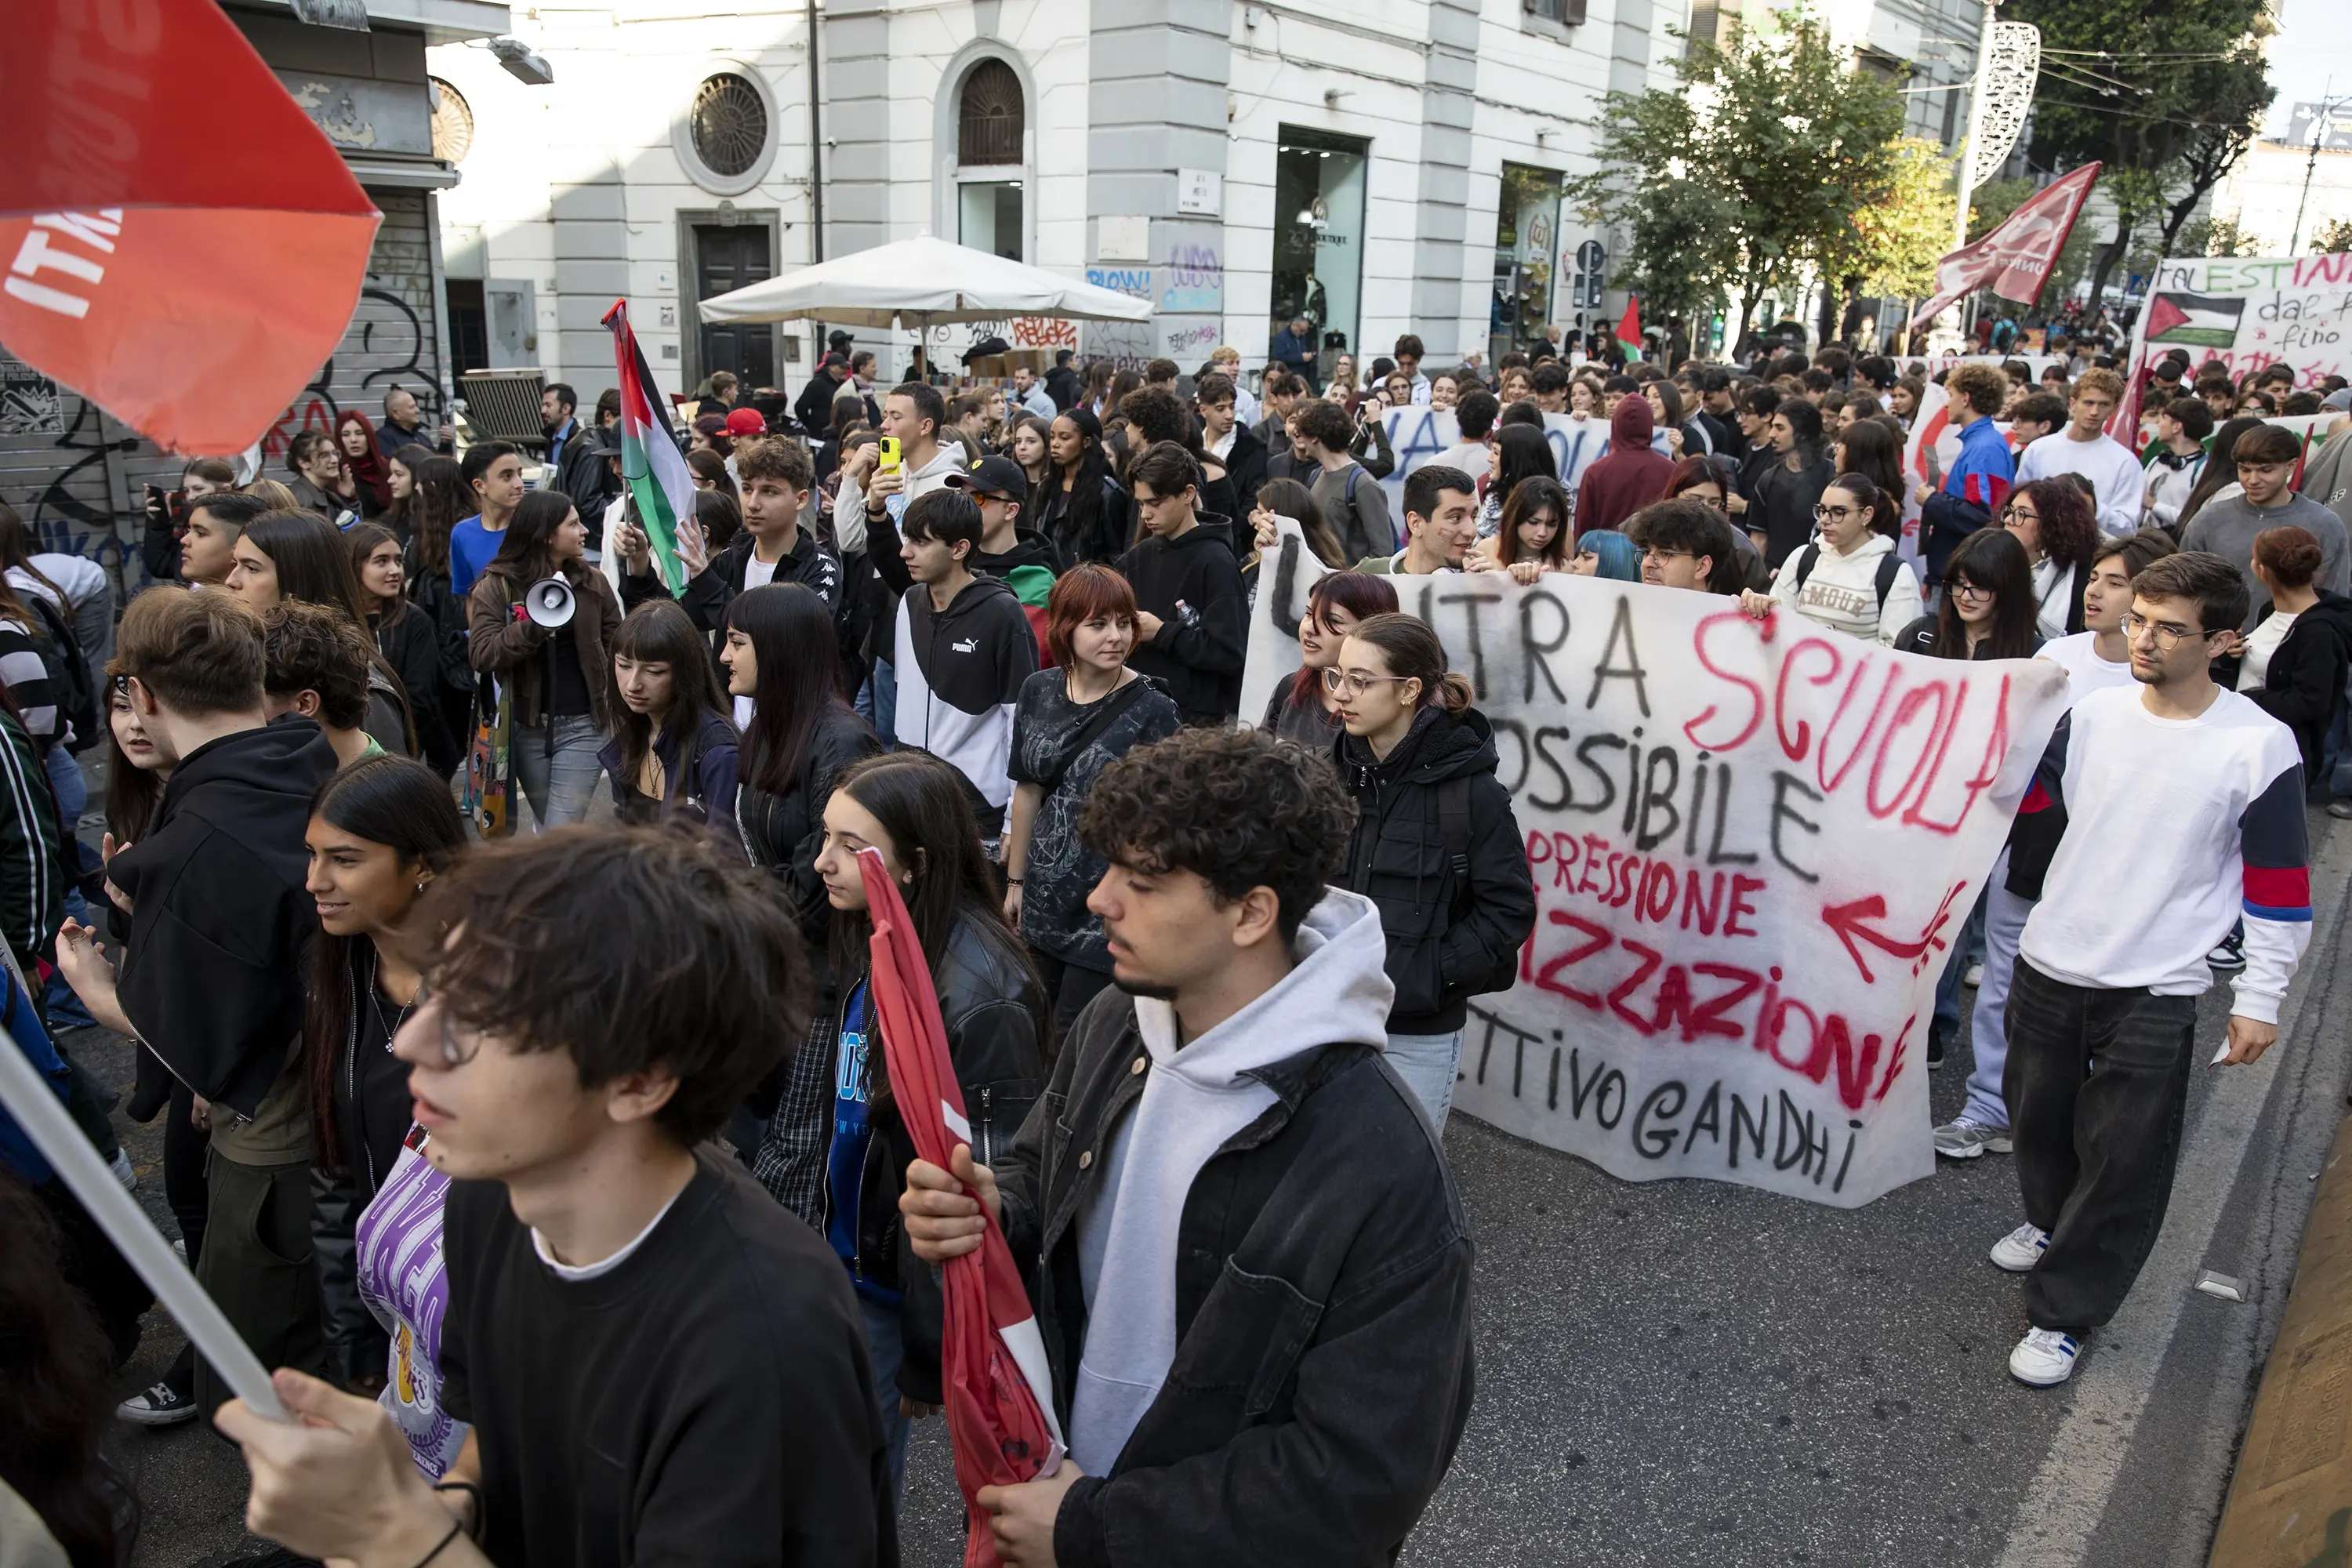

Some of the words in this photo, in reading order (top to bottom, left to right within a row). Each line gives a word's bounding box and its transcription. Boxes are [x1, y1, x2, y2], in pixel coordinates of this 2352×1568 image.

[952, 642, 972, 653] PUMA
[1527, 829, 1767, 938] PRESSIONE
[412, 1450, 440, 1476] ERENCE
